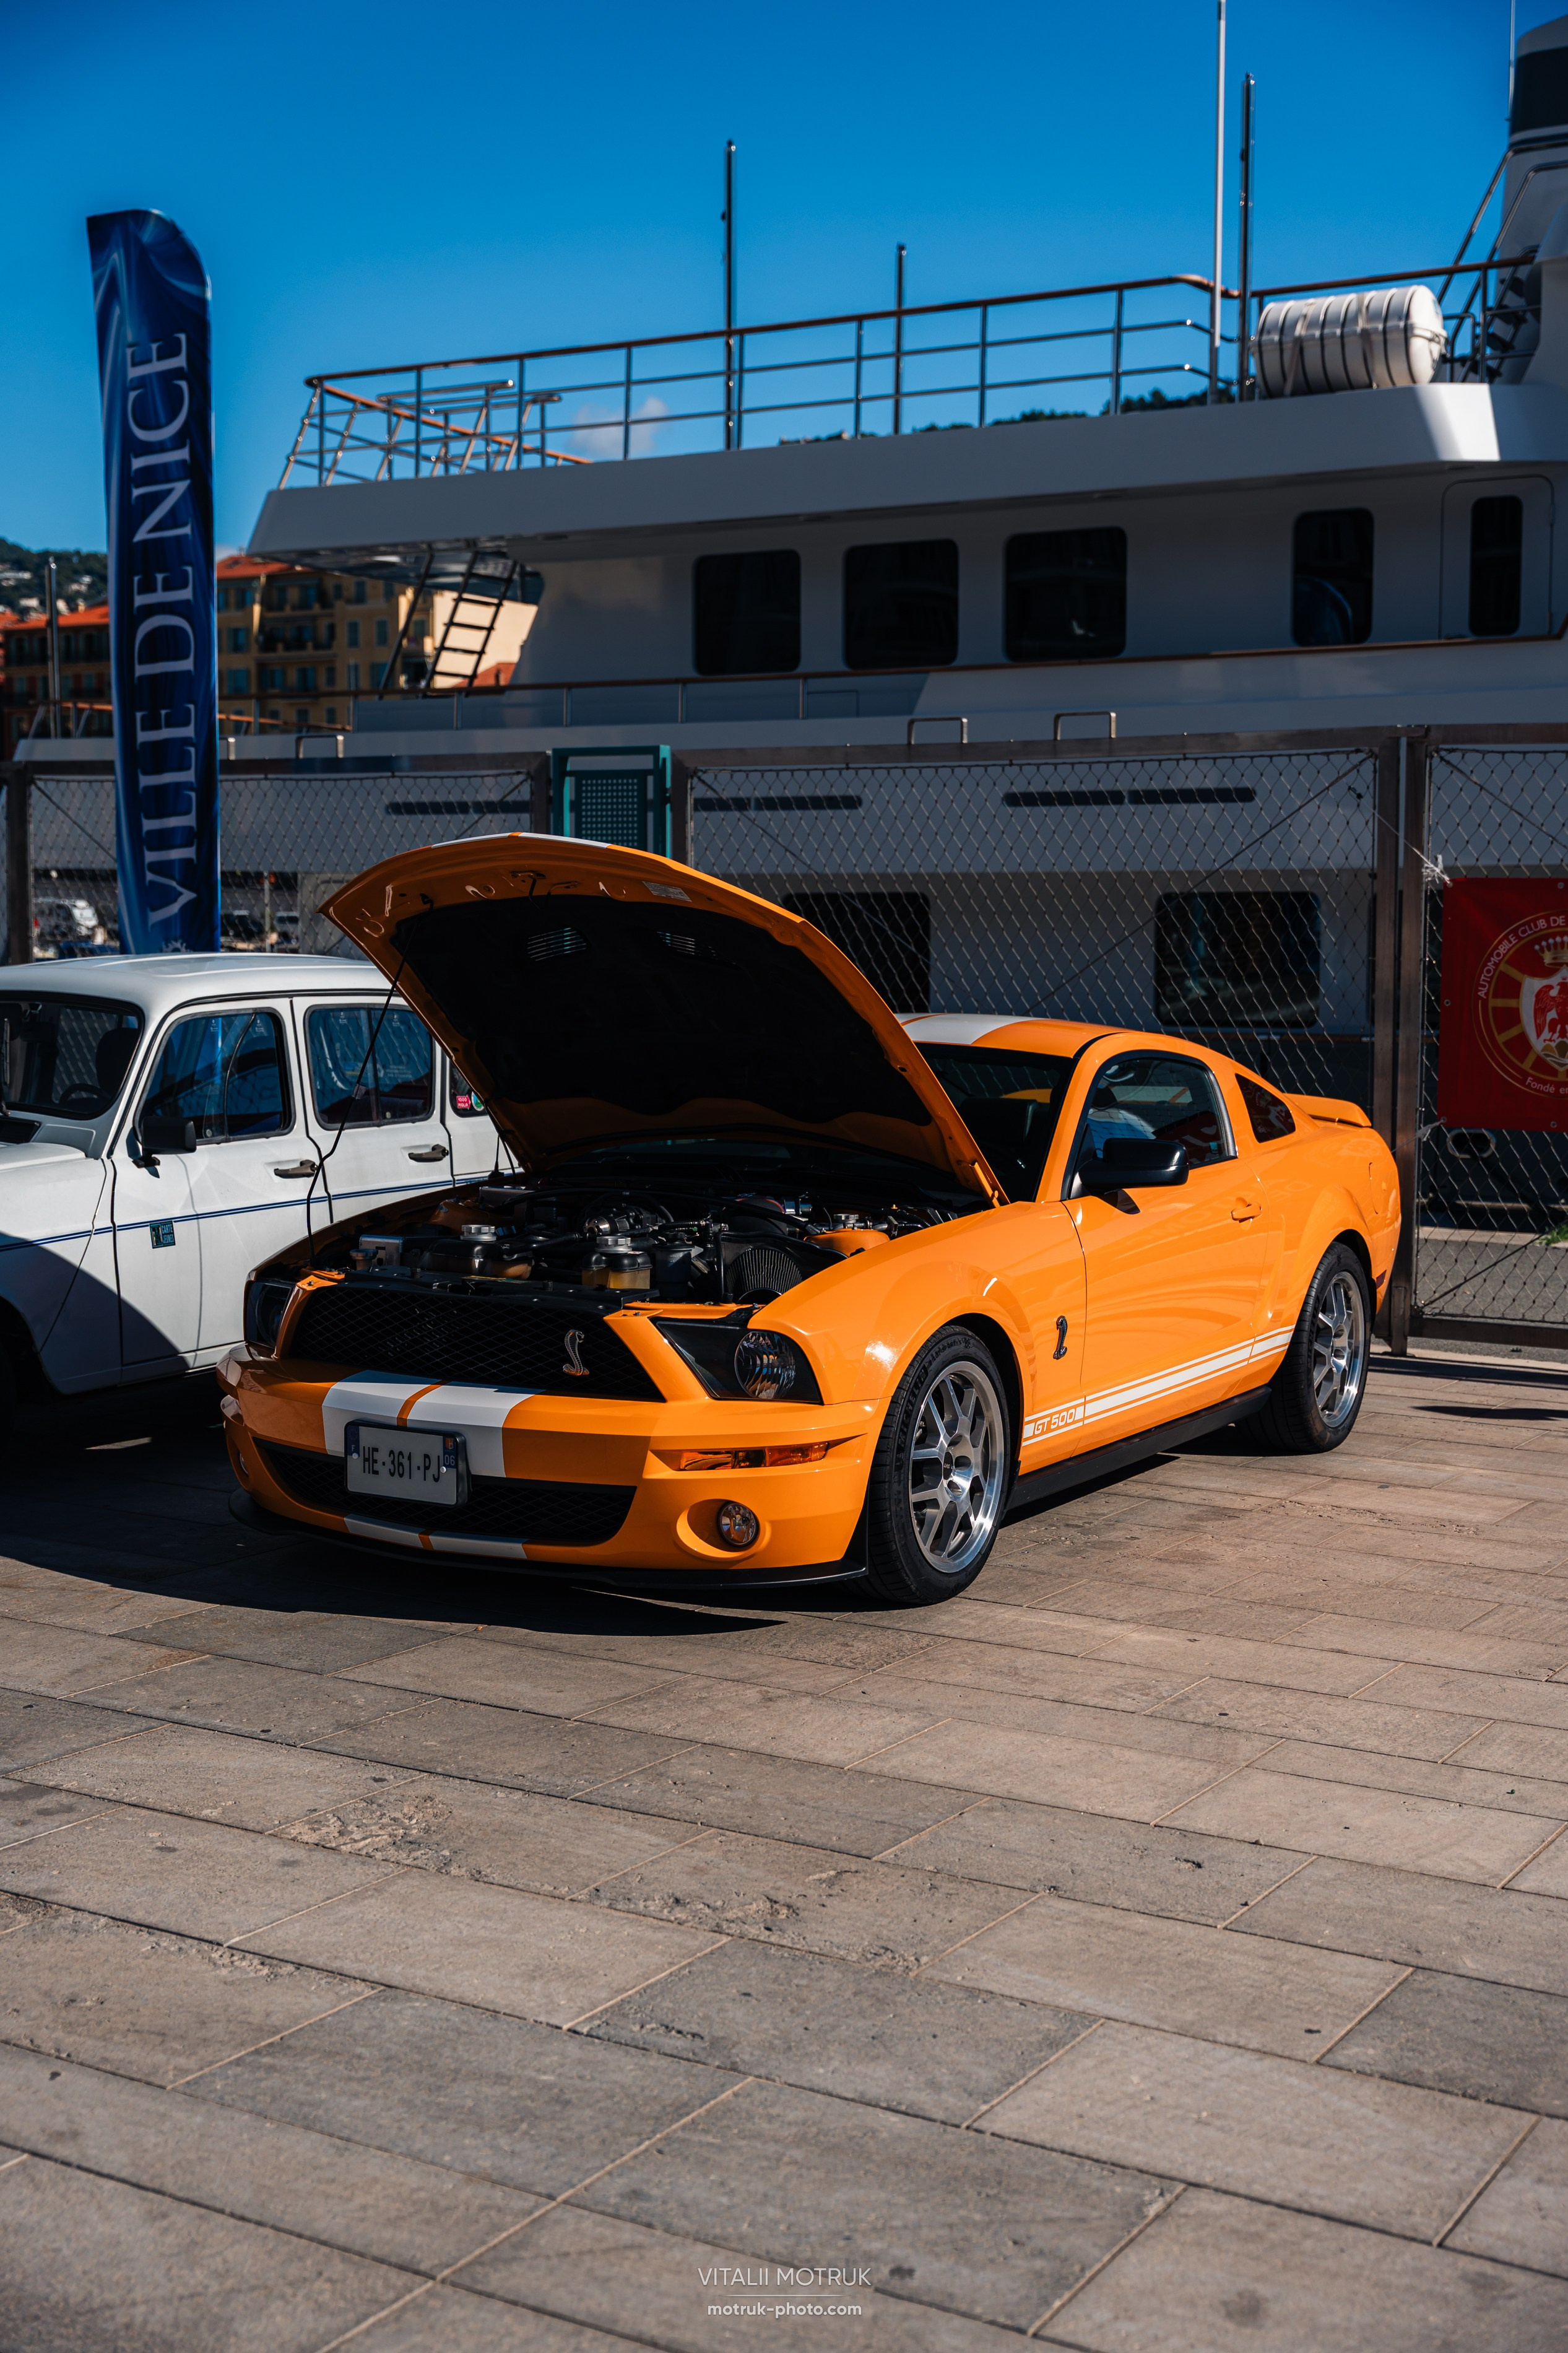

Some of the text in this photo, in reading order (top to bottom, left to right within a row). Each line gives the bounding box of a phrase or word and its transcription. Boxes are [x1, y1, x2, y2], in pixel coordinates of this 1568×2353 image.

[127, 333, 198, 933] VILLE DE NICE
[1477, 915, 1567, 998] AUTOMOBILE CLUB DE
[1525, 1077, 1556, 1094] Fondé
[162, 1224, 173, 1233] CARTE
[899, 1368, 928, 1446] MICHELIN
[1034, 1408, 1075, 1435] GT 500
[444, 1454, 455, 1466] 06
